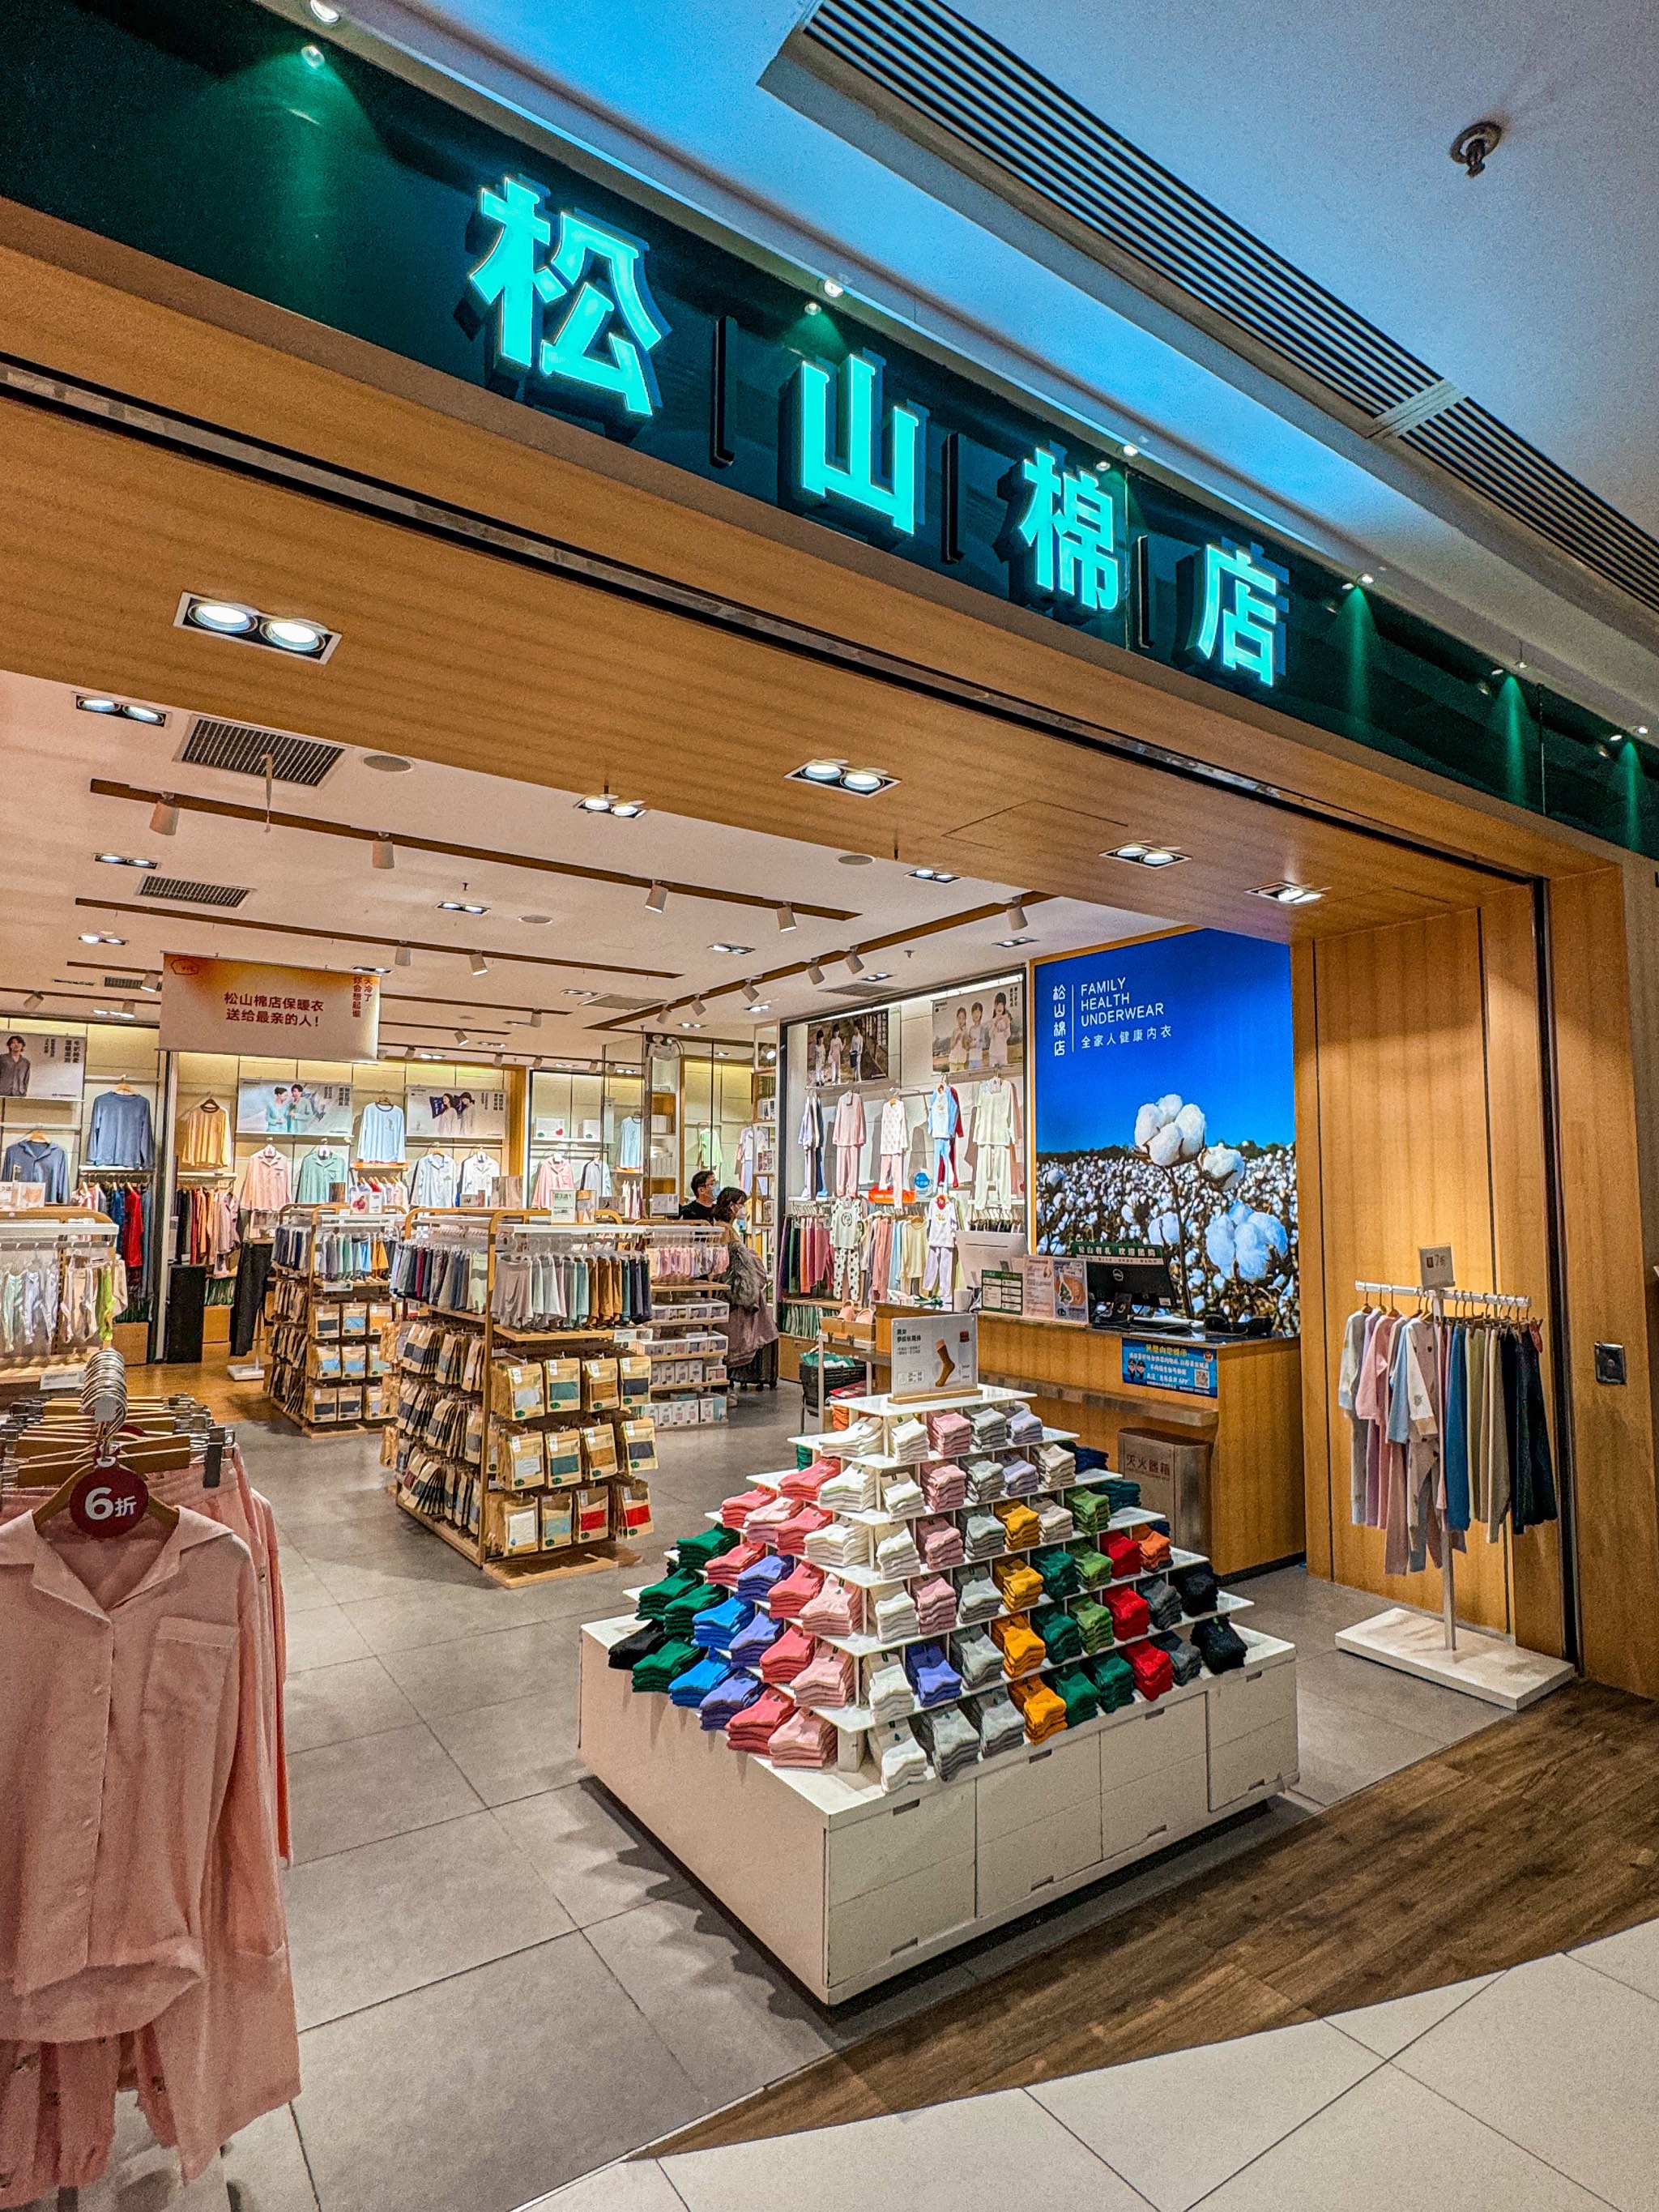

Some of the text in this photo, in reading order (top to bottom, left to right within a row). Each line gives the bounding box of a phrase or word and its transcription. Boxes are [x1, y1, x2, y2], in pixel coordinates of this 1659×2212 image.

[469, 176, 1277, 686] 松山棉店
[1080, 976, 1127, 997] FAMILY
[224, 991, 325, 1012] 松山棉店保暖衣
[1080, 992, 1131, 1012] HEALTH
[1080, 1001, 1165, 1027] UNDERWEAR
[1053, 984, 1067, 1057] 松山棉店
[1081, 1024, 1173, 1049] 全家人健康内衣
[1126, 1454, 1171, 1476] 灭火器箱
[84, 1486, 138, 1521] 6折
